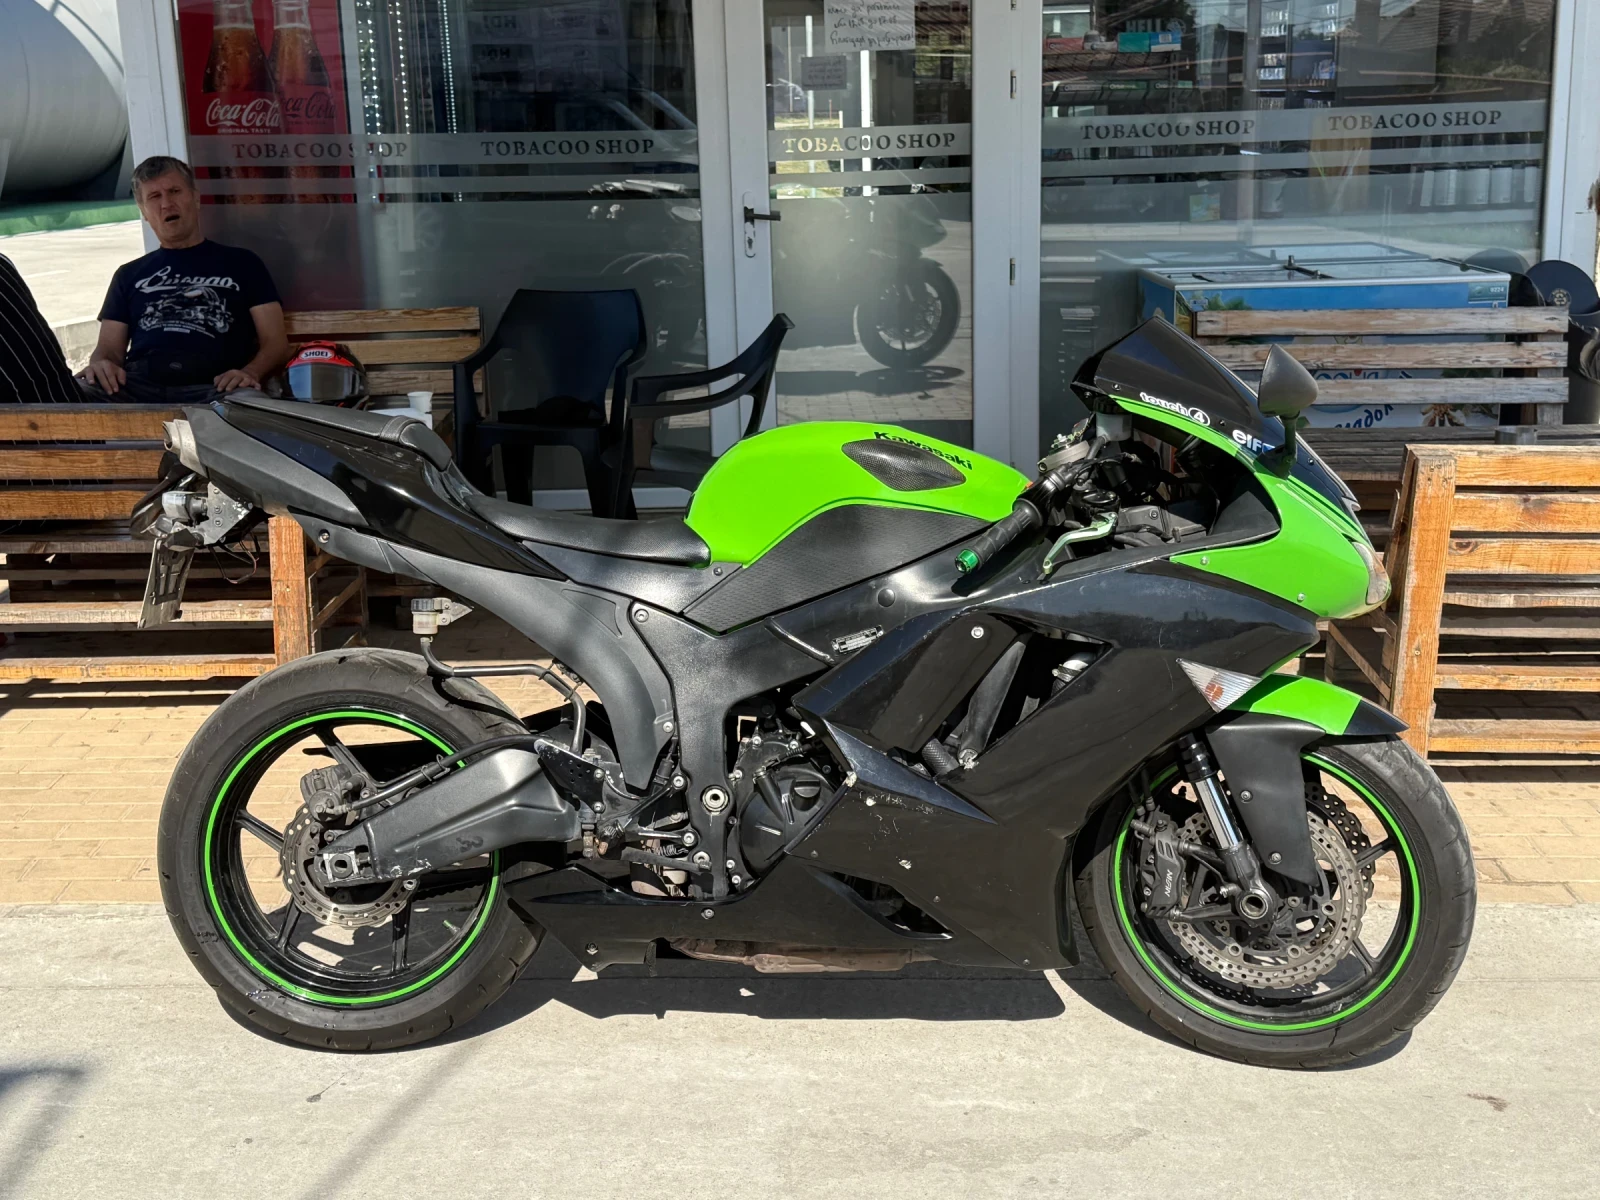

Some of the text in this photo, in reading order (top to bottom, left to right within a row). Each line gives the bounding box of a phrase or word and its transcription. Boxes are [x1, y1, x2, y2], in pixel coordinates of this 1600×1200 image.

[1080, 119, 1255, 140] TOBACOO SHOP
[1328, 110, 1502, 131] TOBACOO SHOP
[232, 142, 342, 159] TOBACOO
[480, 138, 654, 156] TOBACOO SHOP
[782, 132, 955, 153] TOBACOO SHOP
[1140, 391, 1189, 416] touch
[874, 431, 973, 470] Kawasaki
